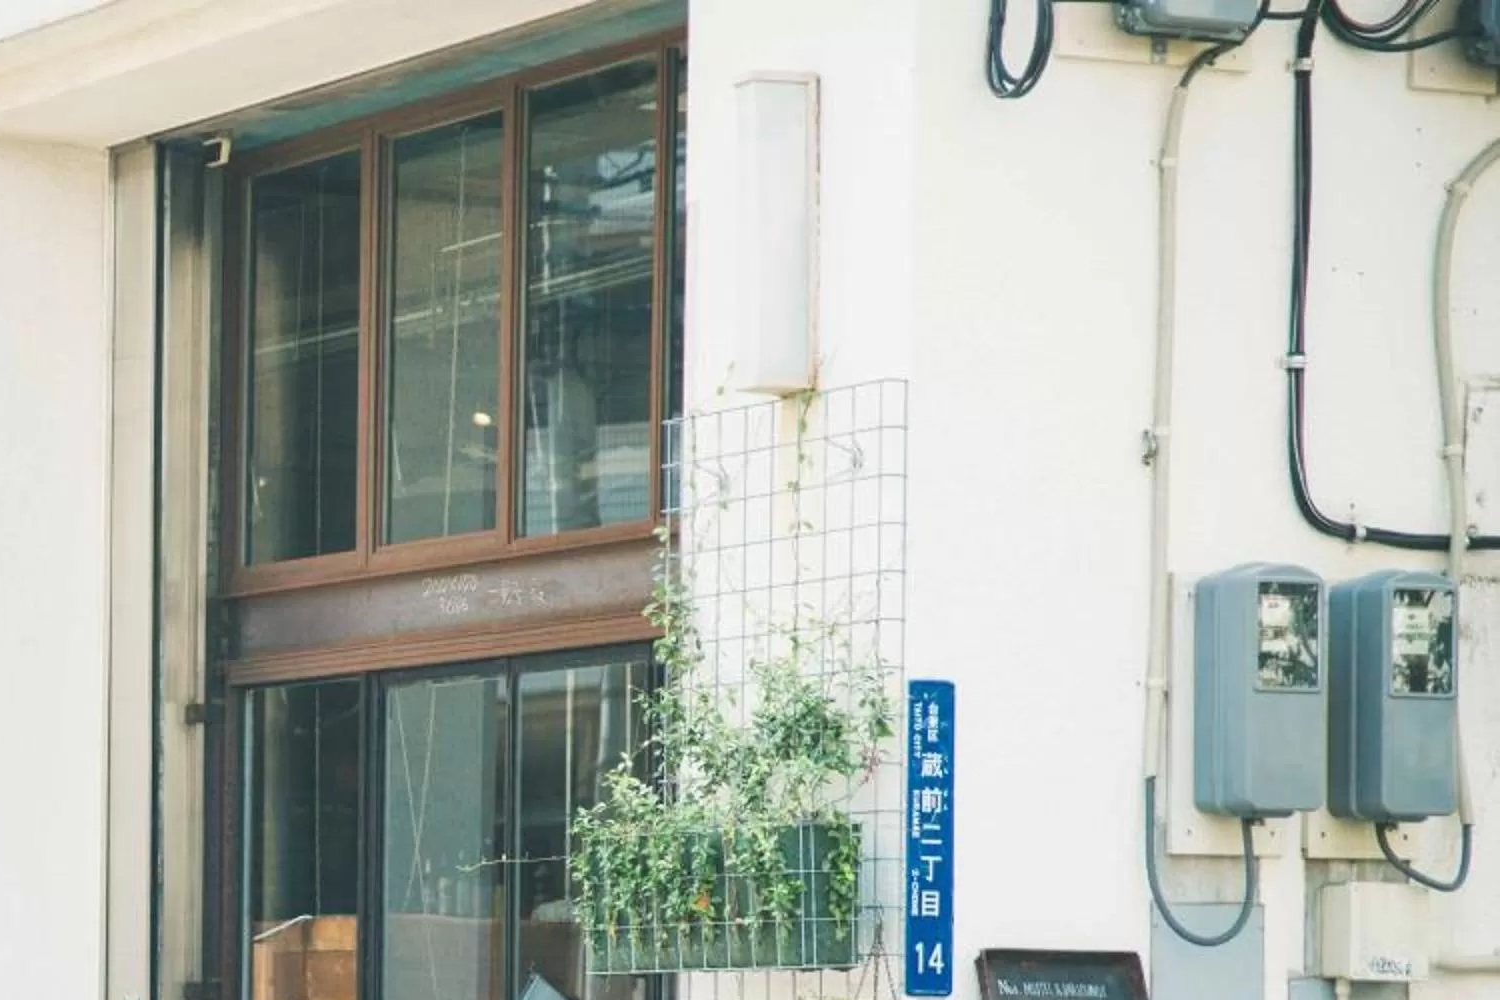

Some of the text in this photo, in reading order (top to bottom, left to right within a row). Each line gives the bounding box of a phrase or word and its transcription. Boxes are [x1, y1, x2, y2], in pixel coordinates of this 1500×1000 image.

[920, 752, 943, 917] 蔵前二丁目
[915, 942, 945, 975] 14
